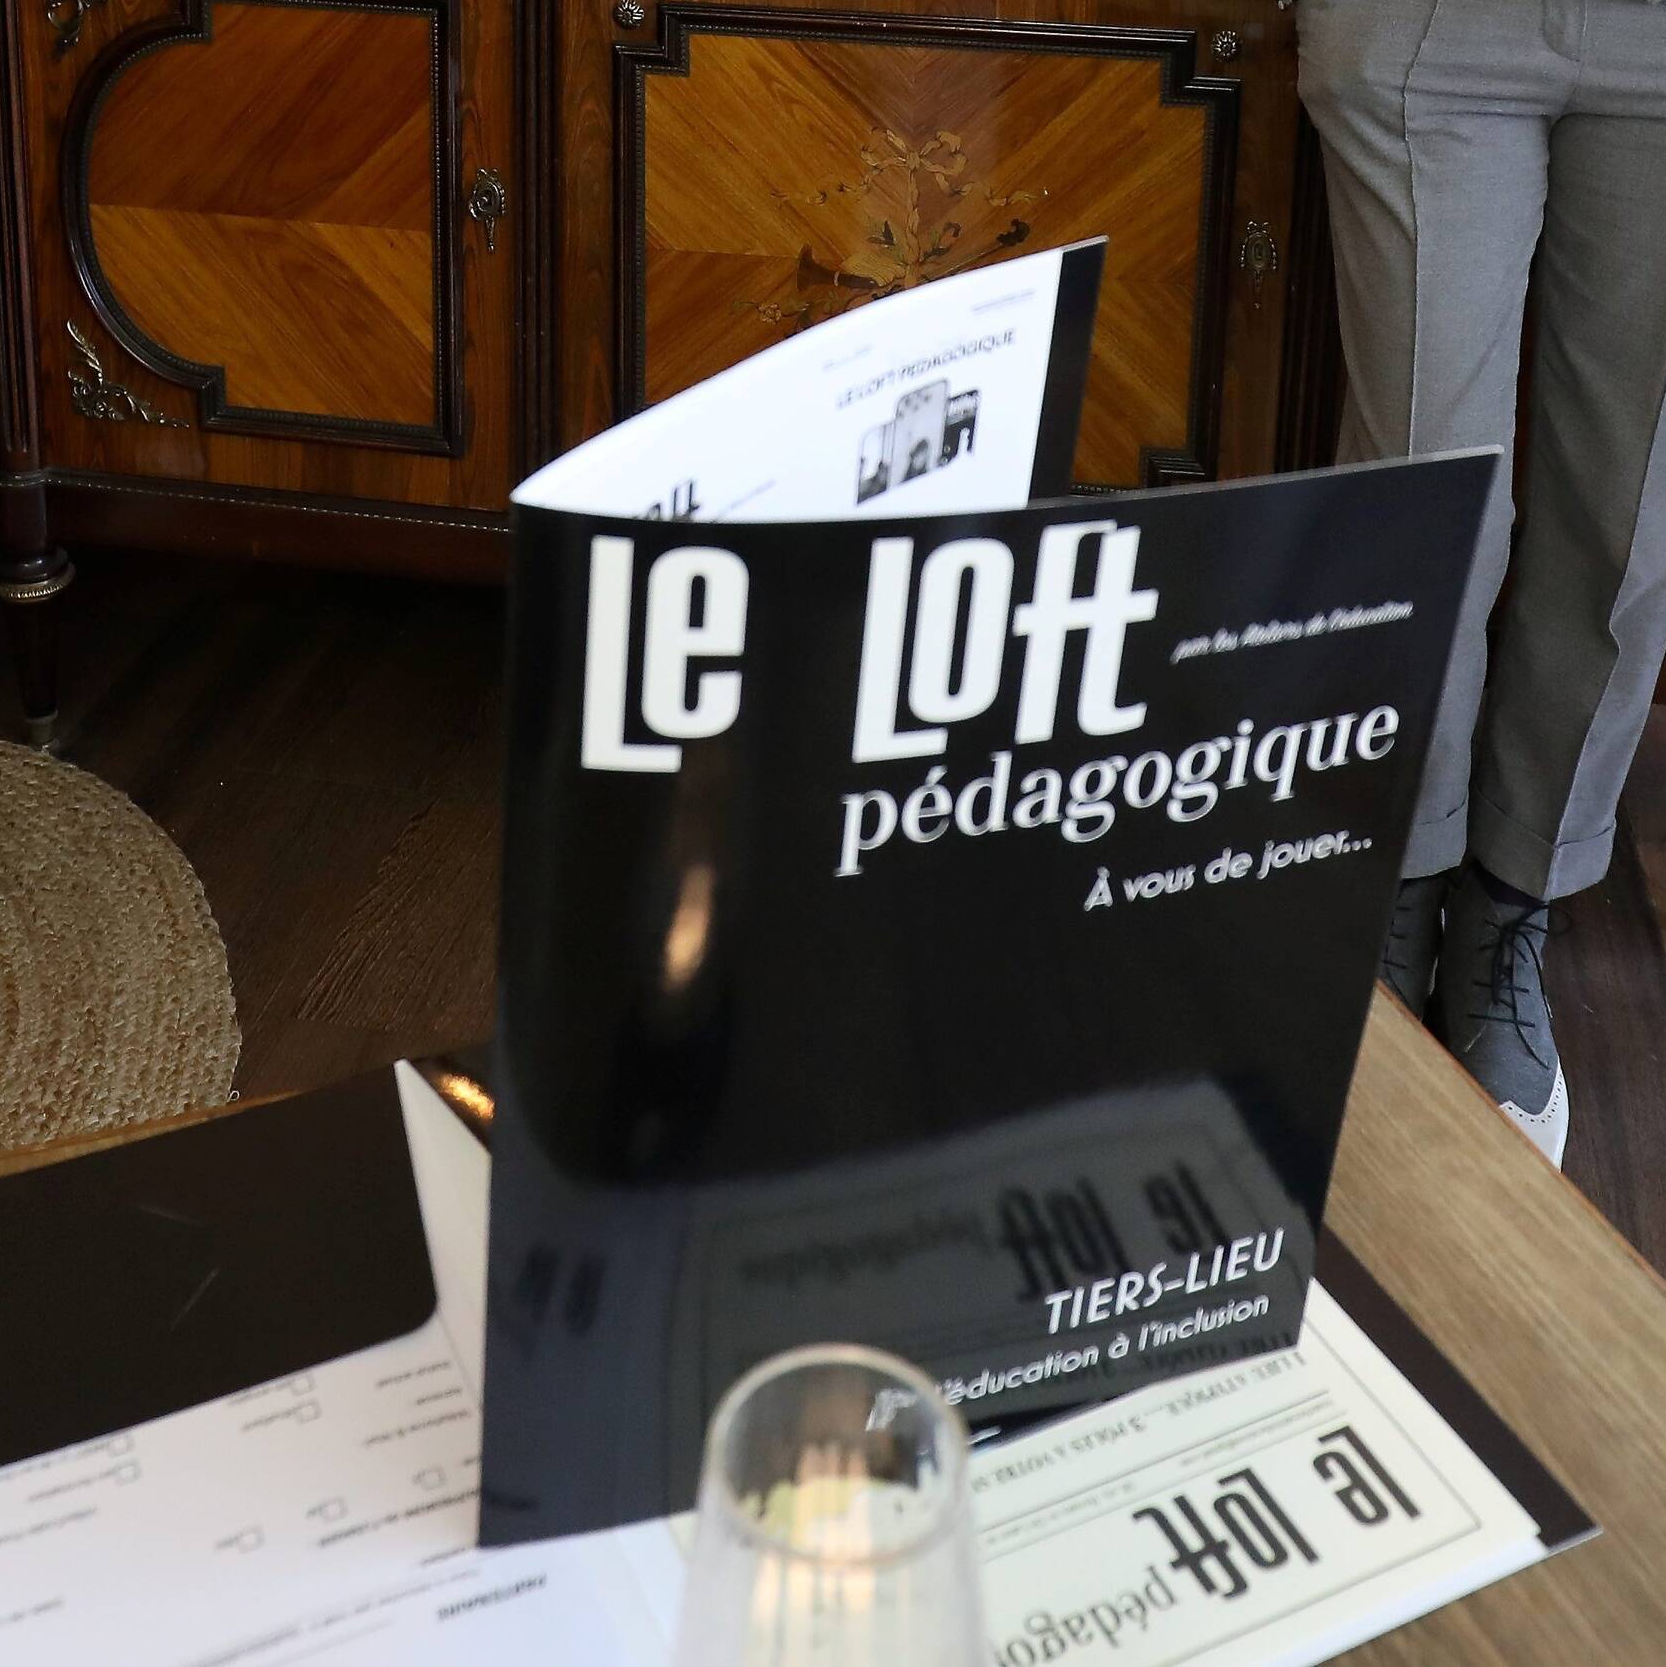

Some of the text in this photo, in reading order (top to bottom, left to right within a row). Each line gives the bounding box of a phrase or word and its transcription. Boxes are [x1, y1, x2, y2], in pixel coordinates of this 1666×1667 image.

[579, 519, 1158, 773] Le Loft
[834, 703, 1402, 878] pédagogique
[1120, 863, 1198, 902] vous
[1203, 845, 1253, 887] de
[1044, 1227, 1284, 1334] TIERS-LIEU
[1107, 1331, 1129, 1361] à
[1136, 1294, 1270, 1352] l'inclusion
